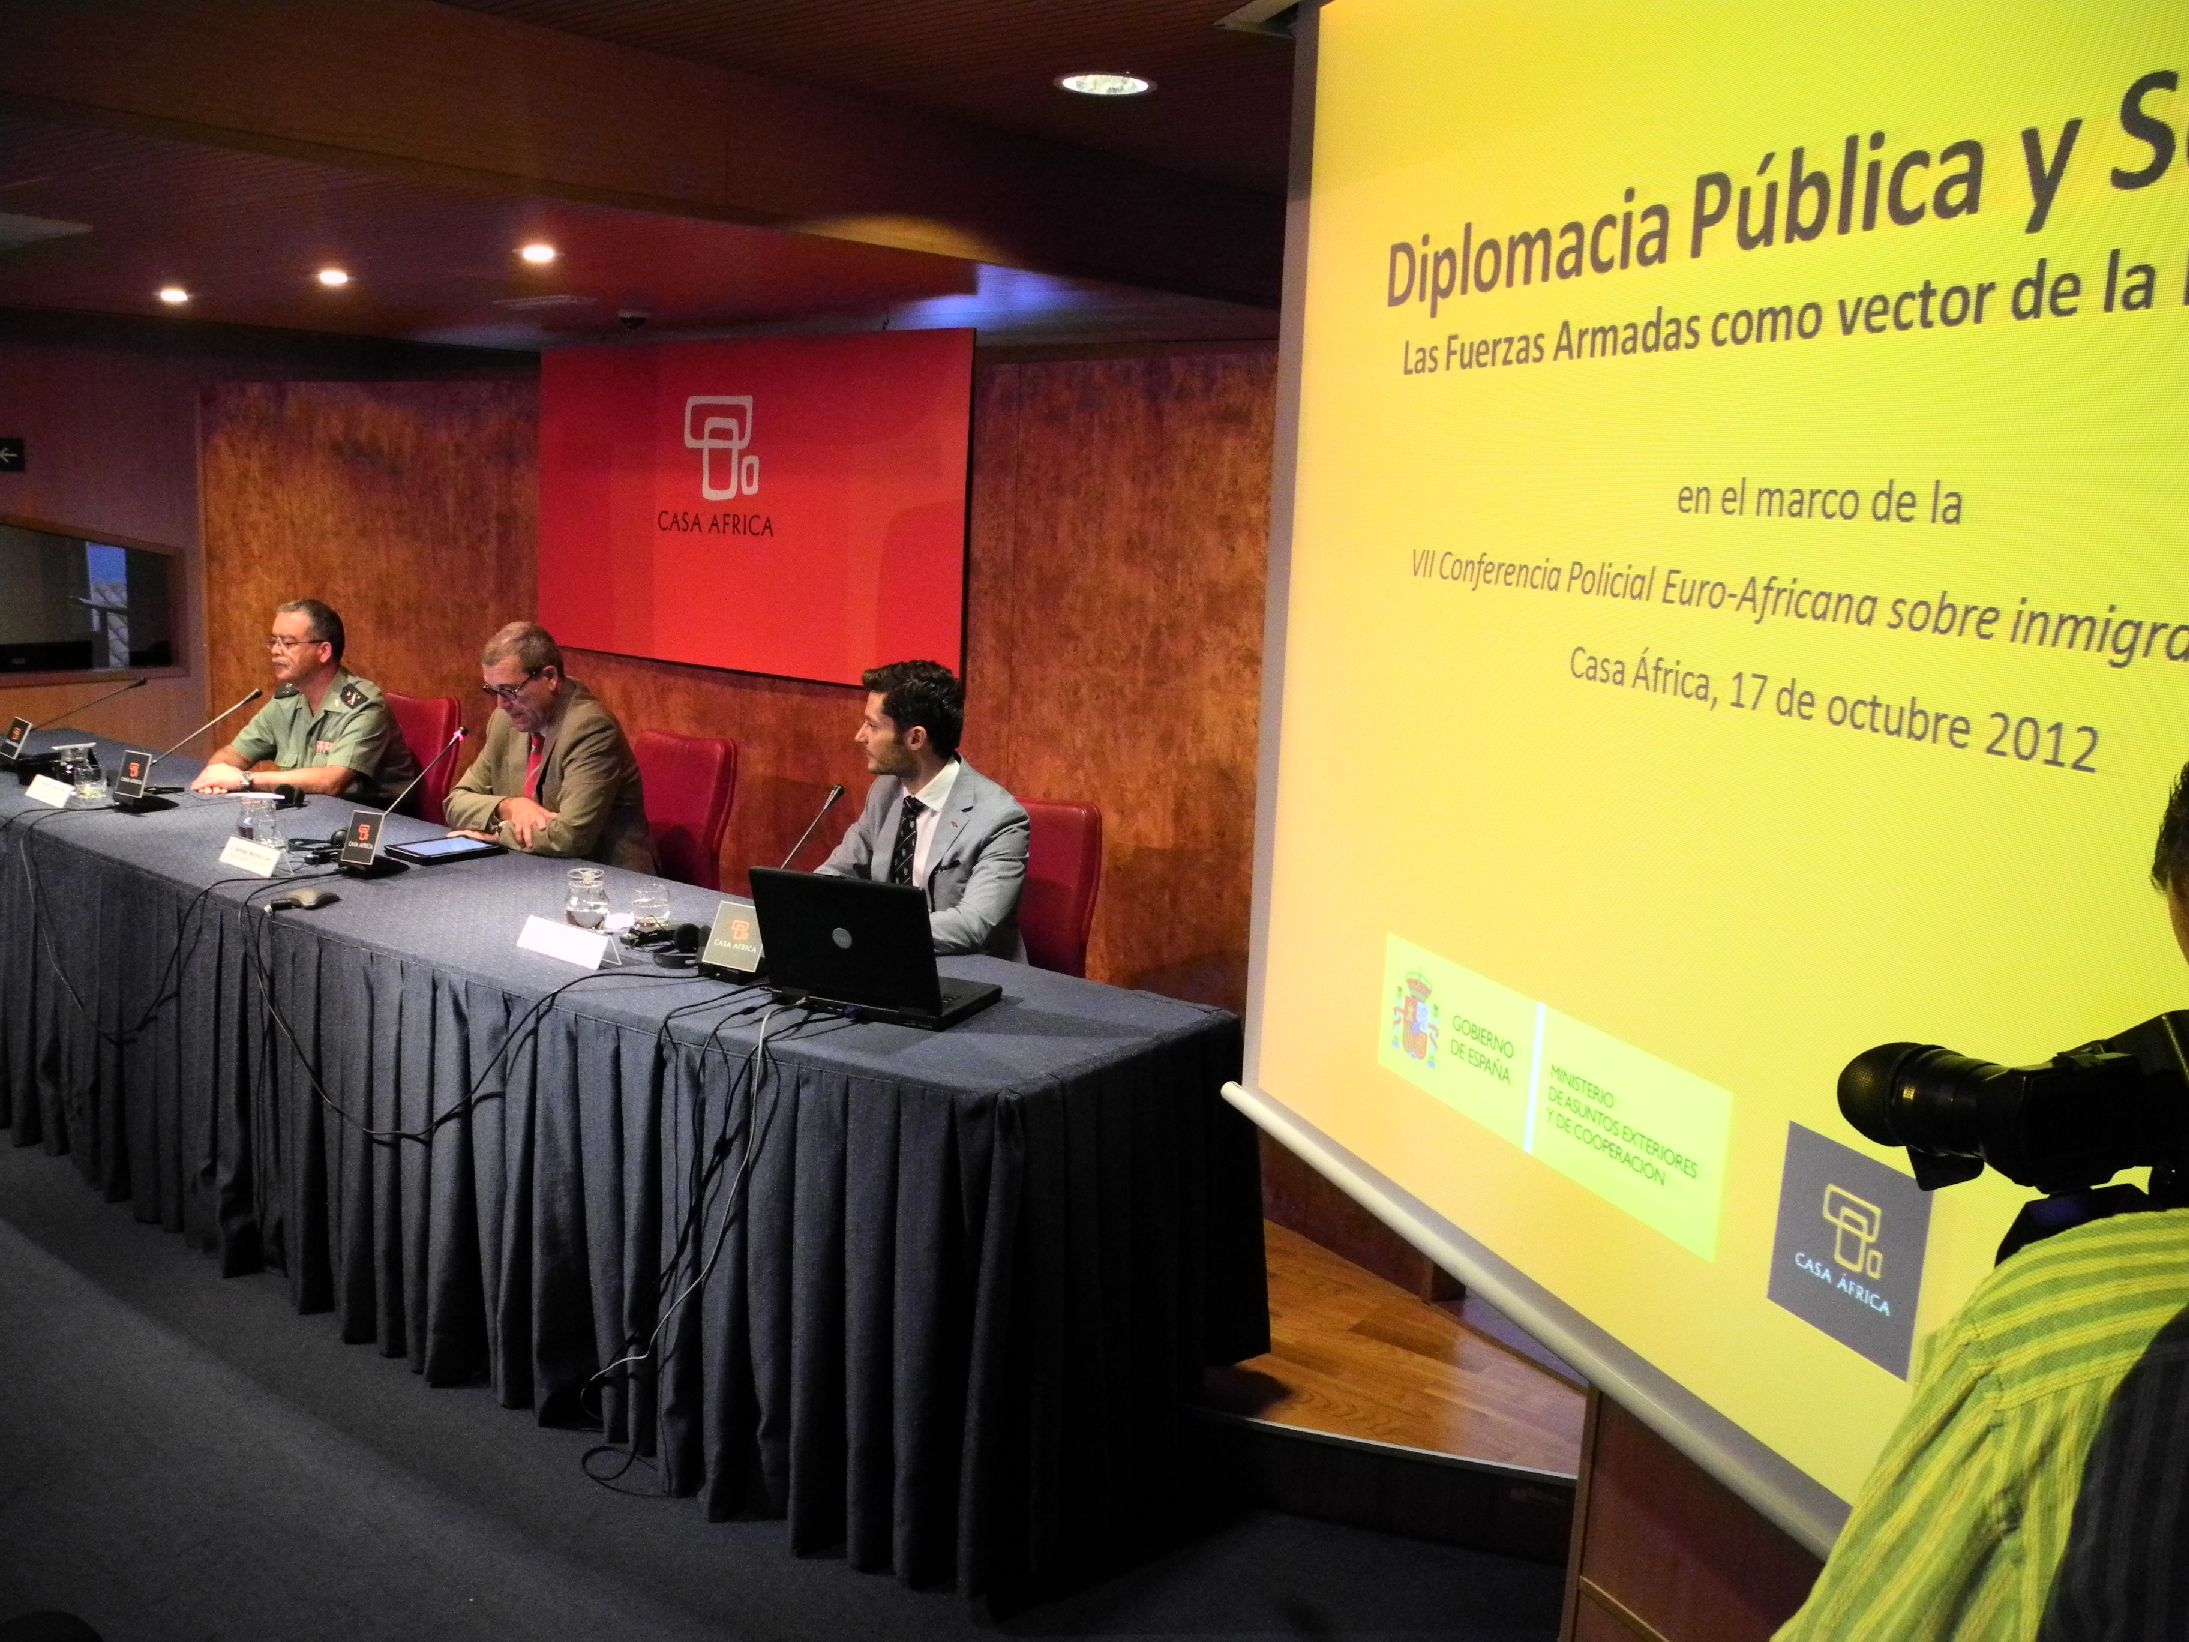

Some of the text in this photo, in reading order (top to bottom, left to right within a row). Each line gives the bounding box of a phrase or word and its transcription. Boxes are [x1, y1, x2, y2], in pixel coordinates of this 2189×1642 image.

[1387, 69, 2189, 319] Diplomacia Pública y S
[1403, 339, 1439, 376] Las
[1445, 332, 1546, 372] Fuerzas
[1552, 305, 1701, 362] Armadas
[1711, 300, 1823, 348] como
[1838, 279, 1997, 337] vector
[2011, 257, 2082, 321] de
[2103, 248, 2156, 314] la
[657, 511, 774, 537] CASA AFRICA
[1677, 476, 1963, 525] en el marco de la
[1411, 548, 2189, 669] VII Conferencia Policial Euro-Africana sobre inmigra
[1569, 645, 2100, 774] Casa África, 17 de octubre 2012
[714, 938, 732, 949] CASA
[1452, 1014, 1516, 1060] GOBIERNO
[1450, 1038, 1513, 1086] DE ESPAÑA
[1550, 1063, 1616, 1109] MINISTERIO
[1546, 1106, 1555, 1123] Y
[1555, 1112, 1573, 1135] DE
[1548, 1085, 1699, 1180] DE ASUNTOS EXTERIORES
[1795, 1252, 1890, 1317] CASA ÁFRICA
